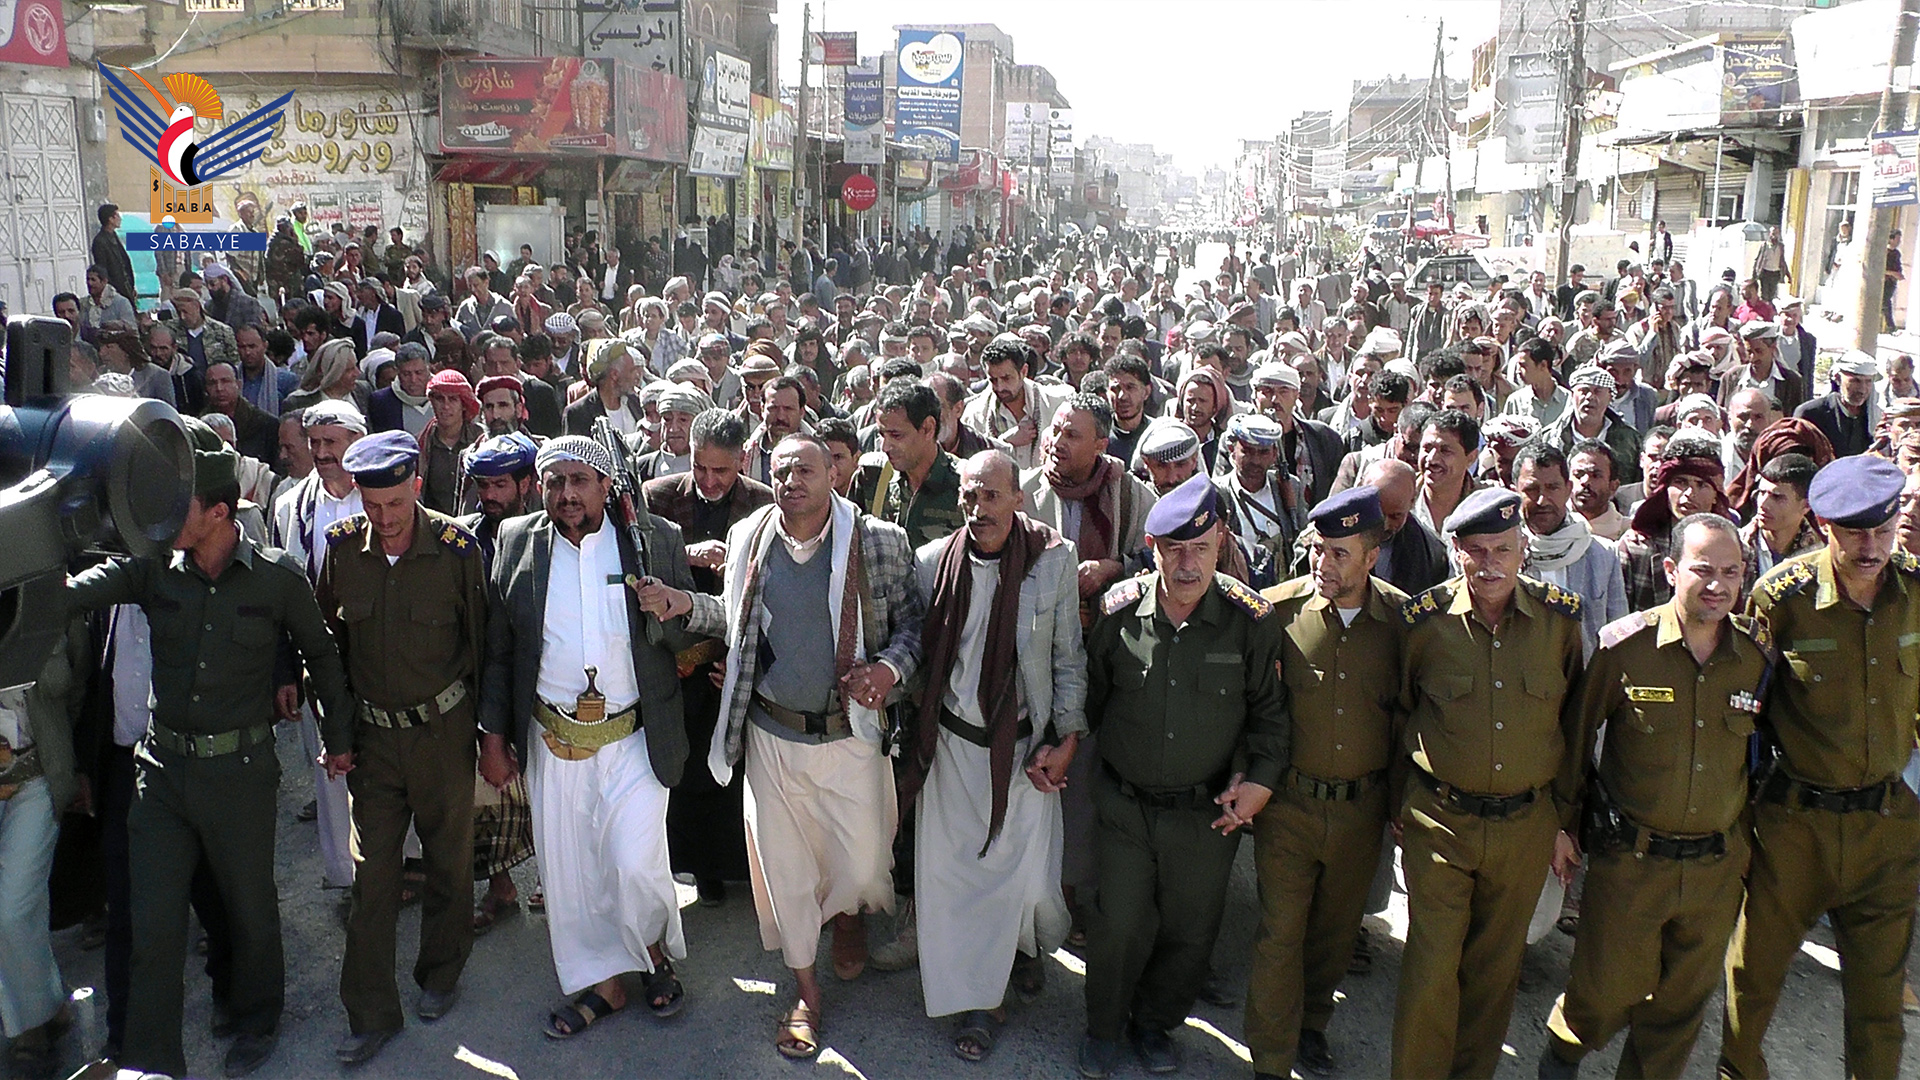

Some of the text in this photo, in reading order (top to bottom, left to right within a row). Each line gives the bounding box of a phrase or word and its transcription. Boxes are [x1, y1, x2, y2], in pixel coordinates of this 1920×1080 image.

[588, 17, 673, 51] المريسي
[294, 96, 399, 140] شاورما
[463, 124, 506, 136] الفخامة
